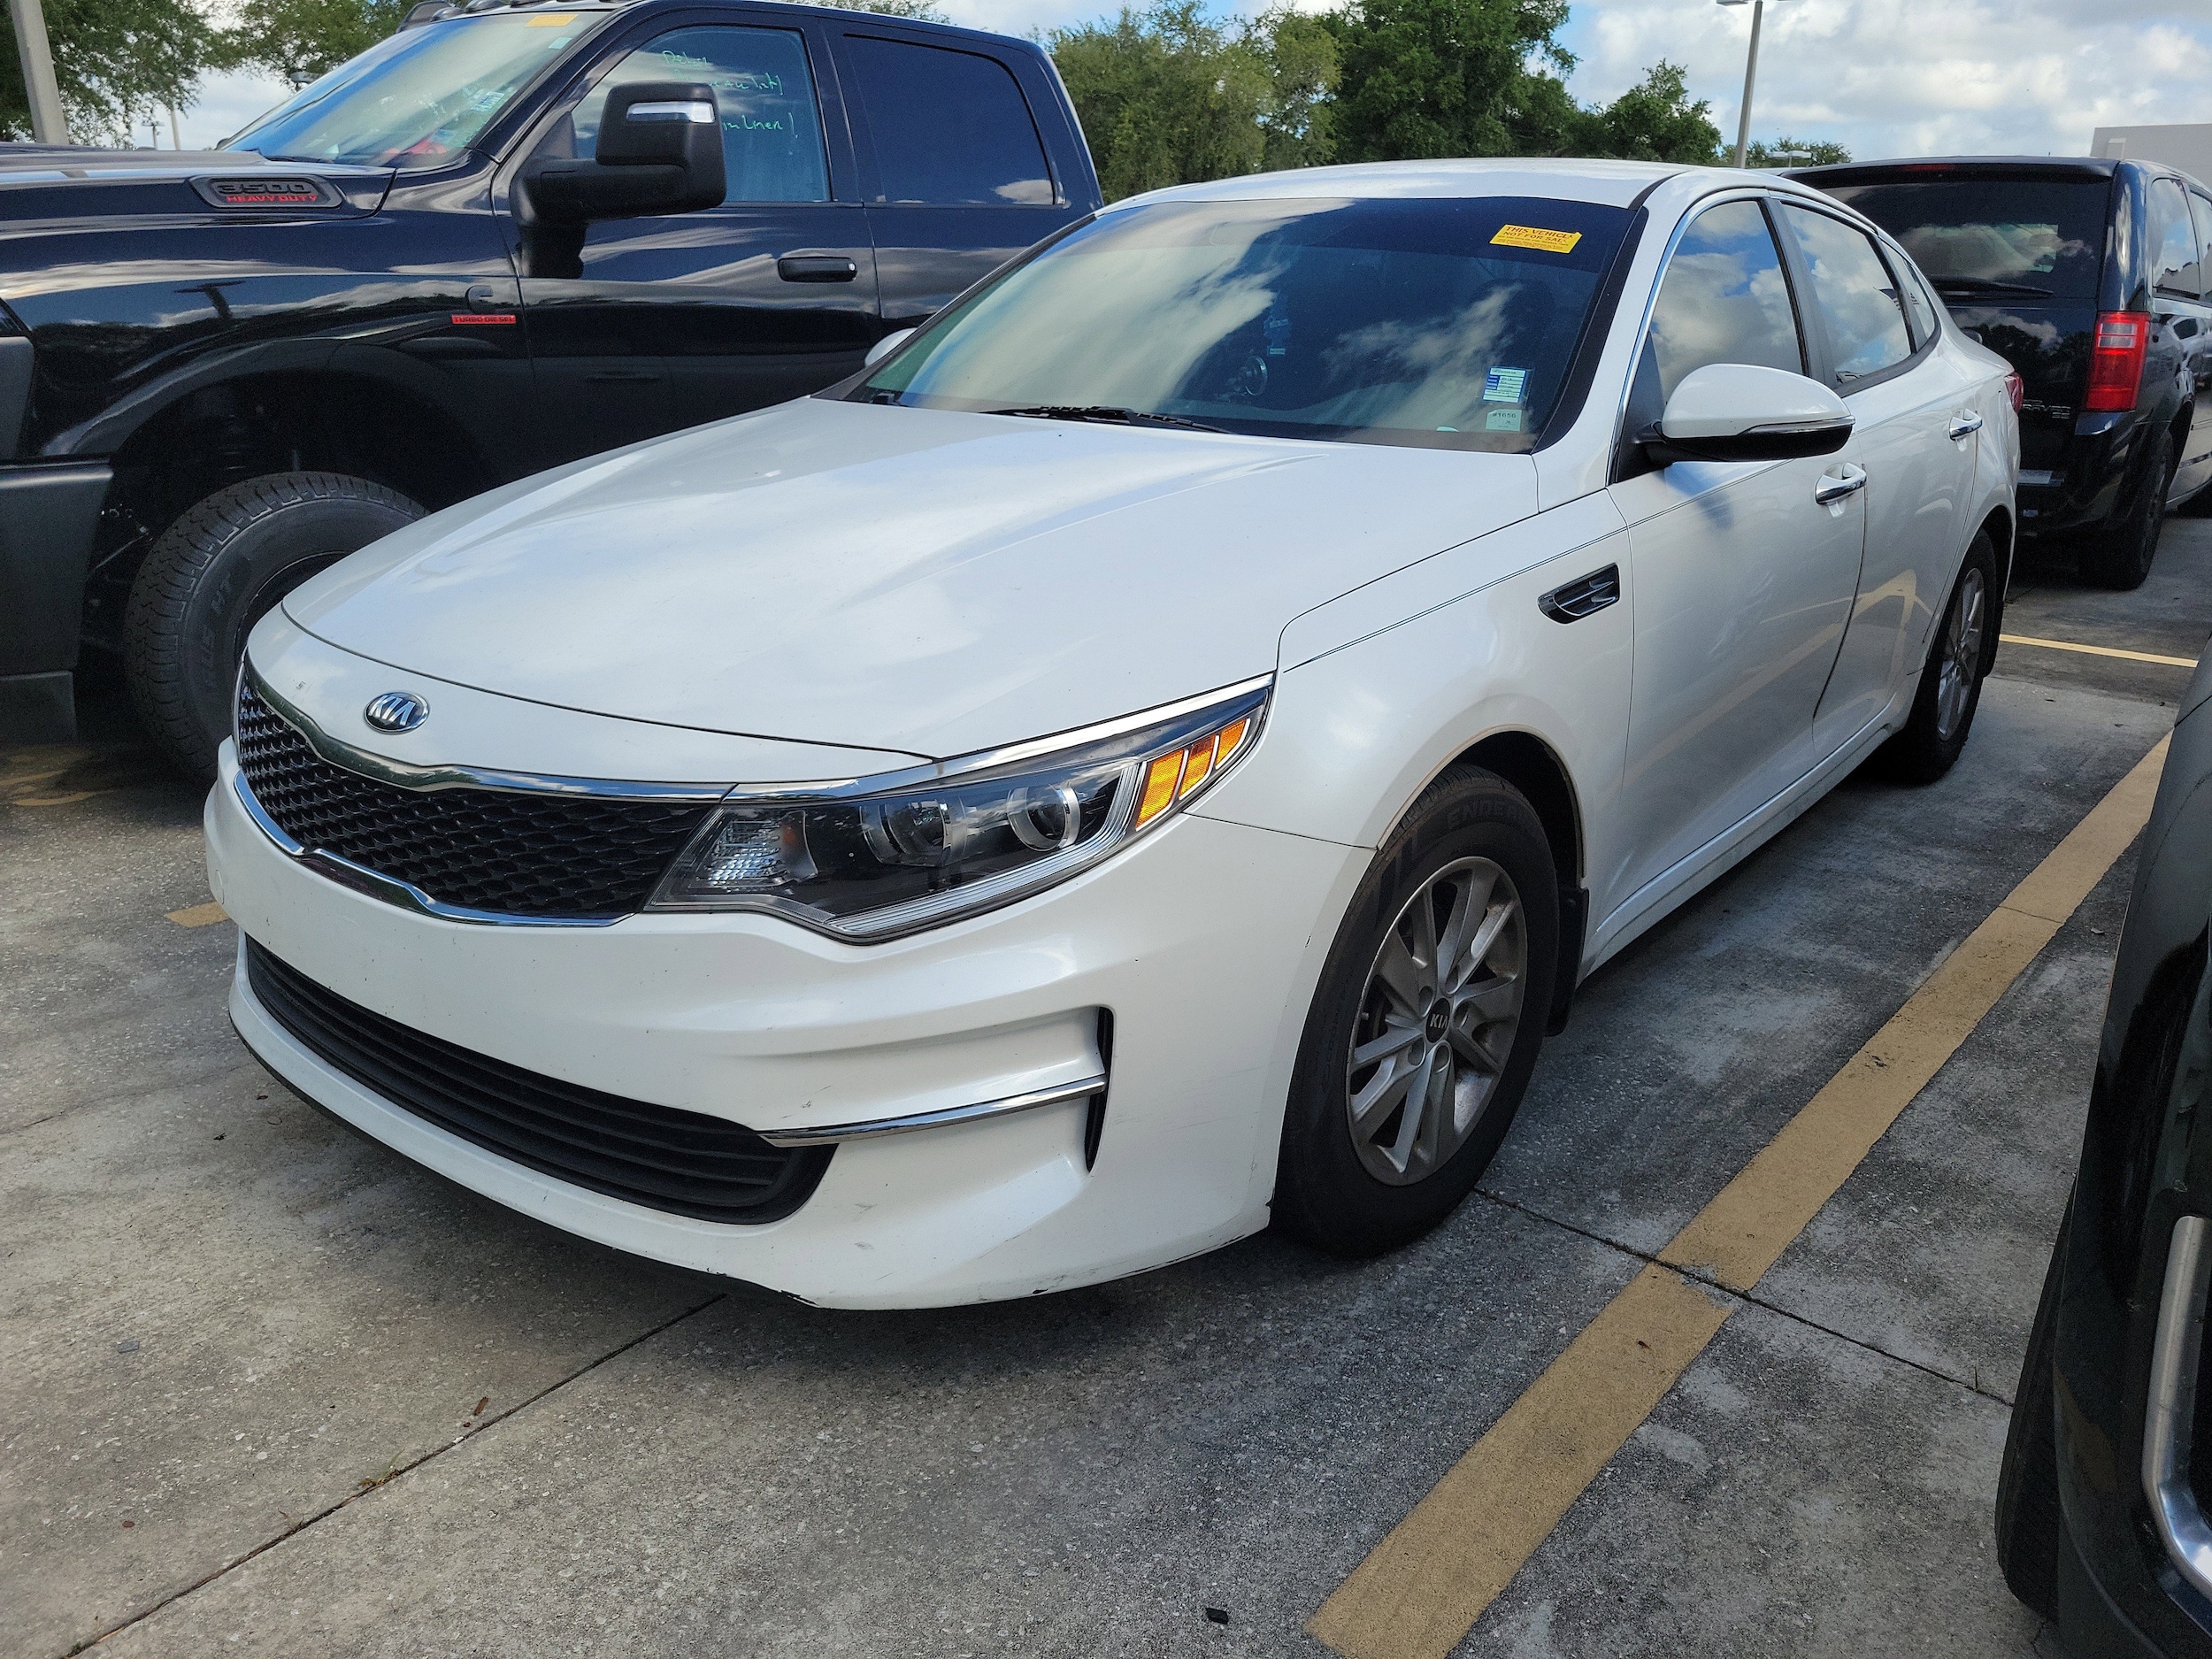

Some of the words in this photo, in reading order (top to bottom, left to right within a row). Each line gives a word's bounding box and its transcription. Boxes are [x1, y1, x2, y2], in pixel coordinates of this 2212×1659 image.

[218, 180, 311, 195] 3500
[367, 695, 417, 726] KIA
[1430, 1013, 1448, 1029] KIA
